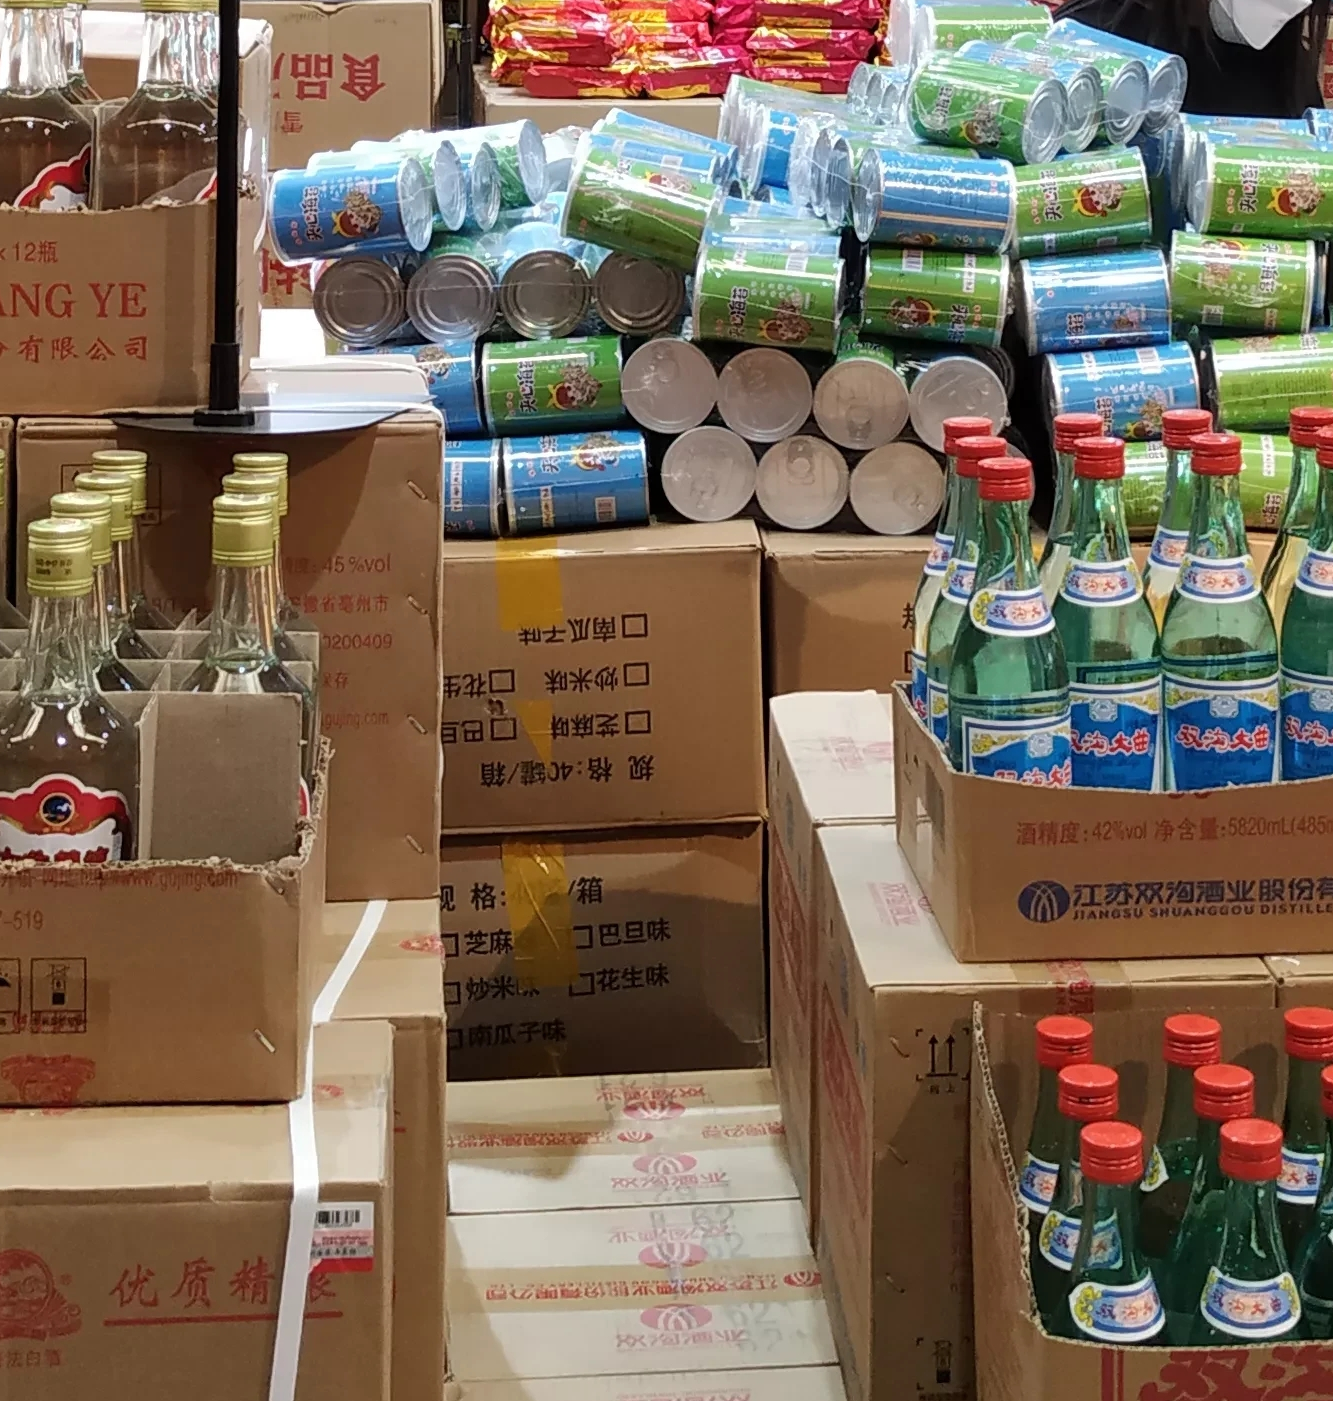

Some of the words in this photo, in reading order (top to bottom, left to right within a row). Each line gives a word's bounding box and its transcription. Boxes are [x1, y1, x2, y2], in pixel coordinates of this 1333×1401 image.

[1040, 165, 1063, 222] 夹心海苔
[304, 184, 324, 243] 夹心海苔
[88, 282, 147, 319] YE
[727, 284, 751, 340] 夹心海苔
[1066, 573, 1129, 595] 双沟大曲
[544, 666, 619, 695] 炒米味
[548, 713, 620, 740] 芝麻味
[1175, 722, 1272, 754] 双沟大曲
[1072, 906, 1144, 921] JIANGSU
[1150, 904, 1256, 919] SHUANGGOU
[598, 917, 672, 947] 巴旦味
[596, 963, 670, 993] 花生味
[467, 1018, 567, 1048] 南瓜子味
